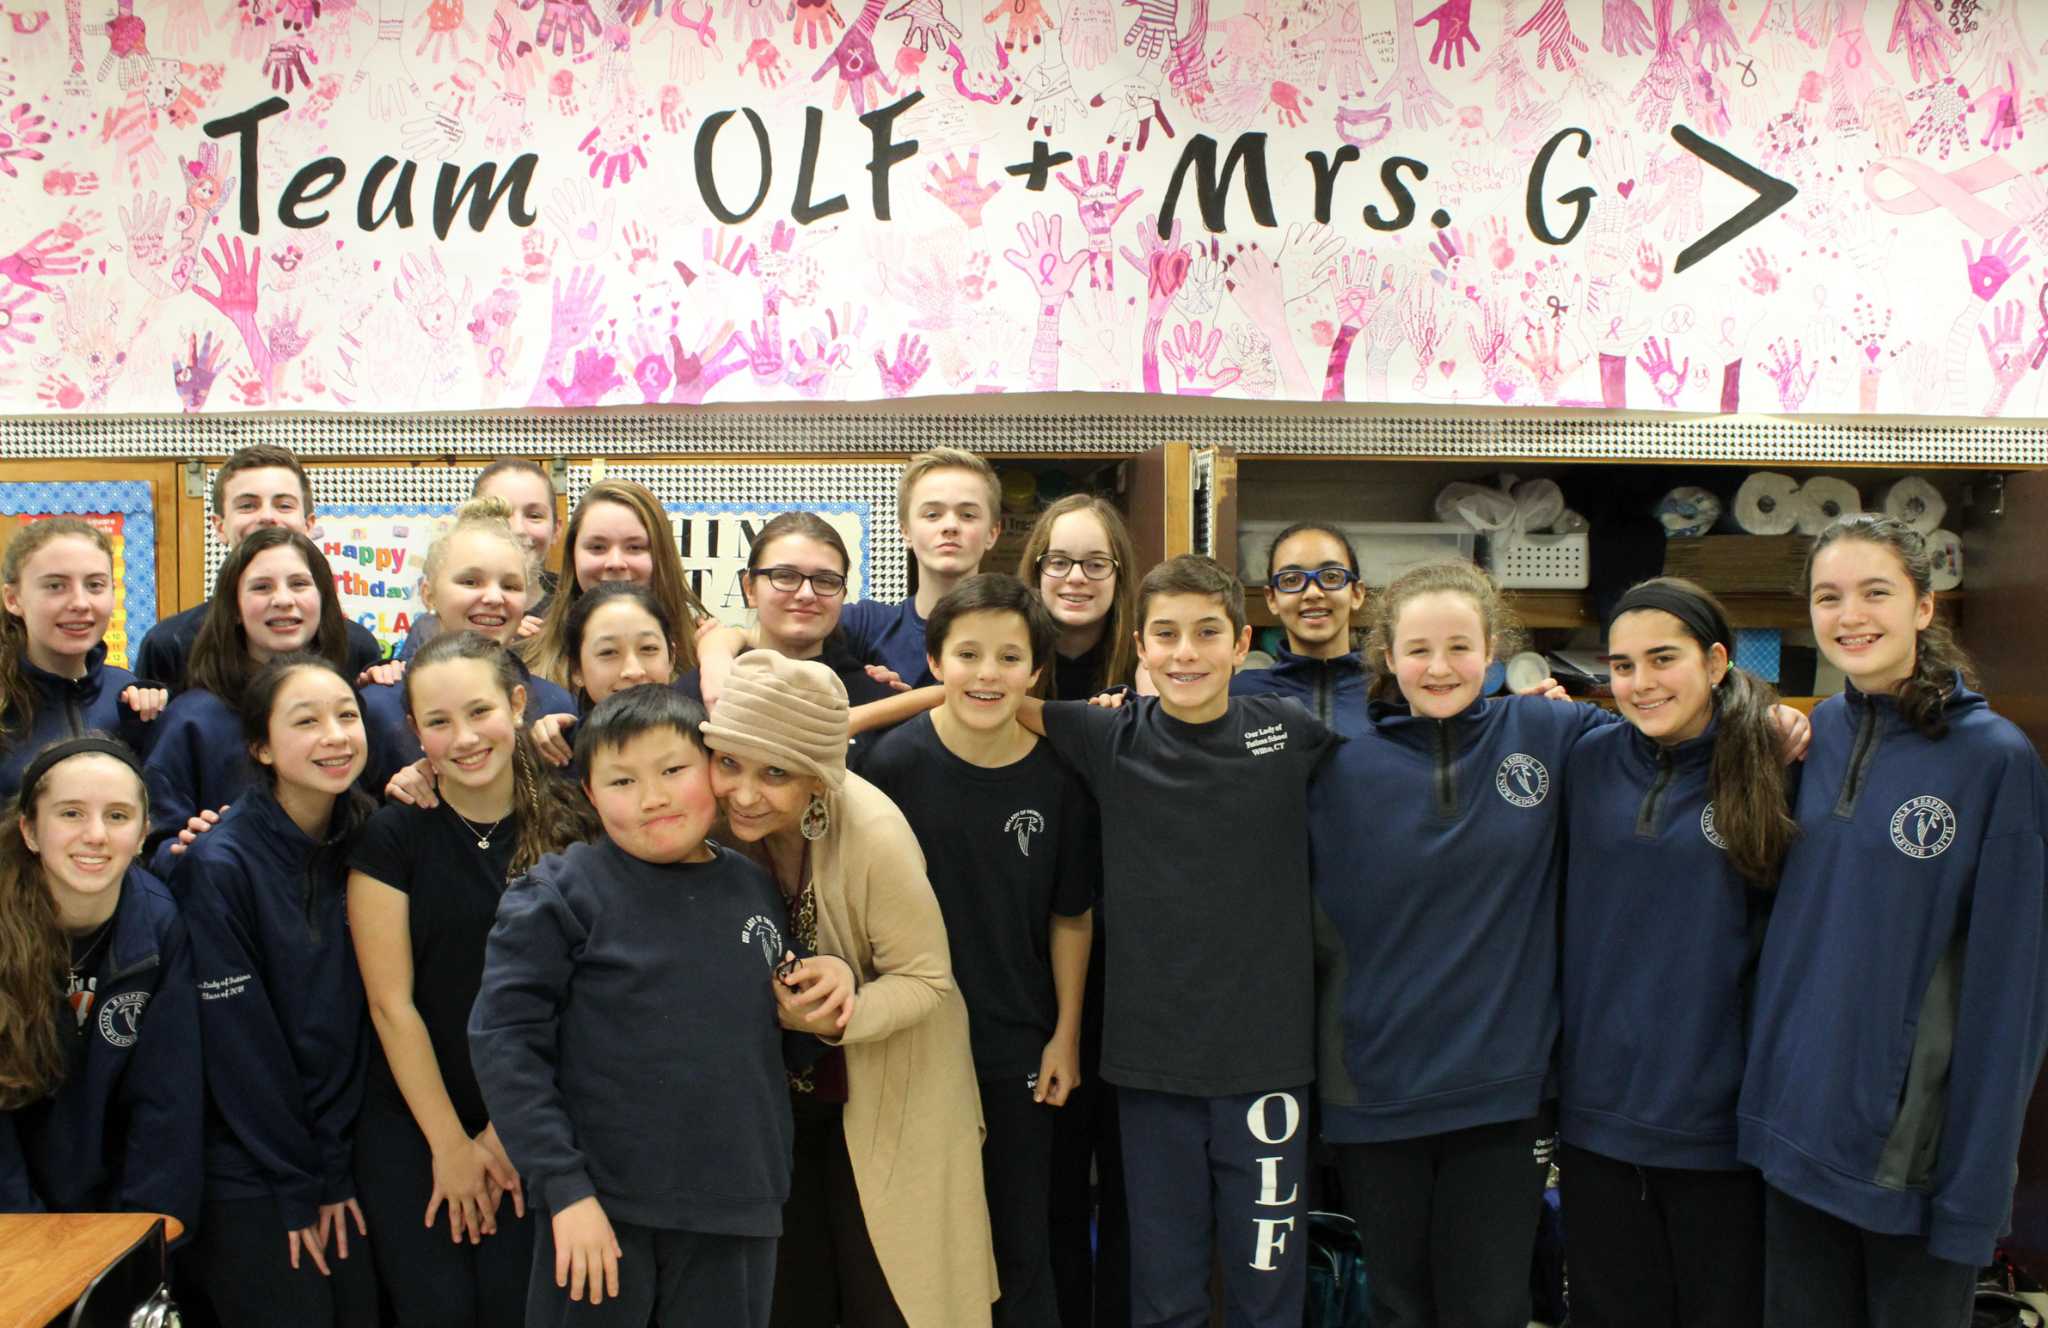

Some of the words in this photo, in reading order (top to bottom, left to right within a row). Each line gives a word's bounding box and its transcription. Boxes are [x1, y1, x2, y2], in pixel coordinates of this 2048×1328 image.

[202, 96, 539, 241] Team
[694, 90, 925, 226] OLF
[1157, 131, 1451, 241] Mrs.
[1525, 127, 1599, 246] G
[672, 518, 768, 559] HIN
[323, 542, 406, 575] Happy
[333, 571, 413, 601] rthday
[1244, 731, 1258, 739] Our
[1274, 723, 1283, 731] of
[1273, 742, 1285, 751] CT
